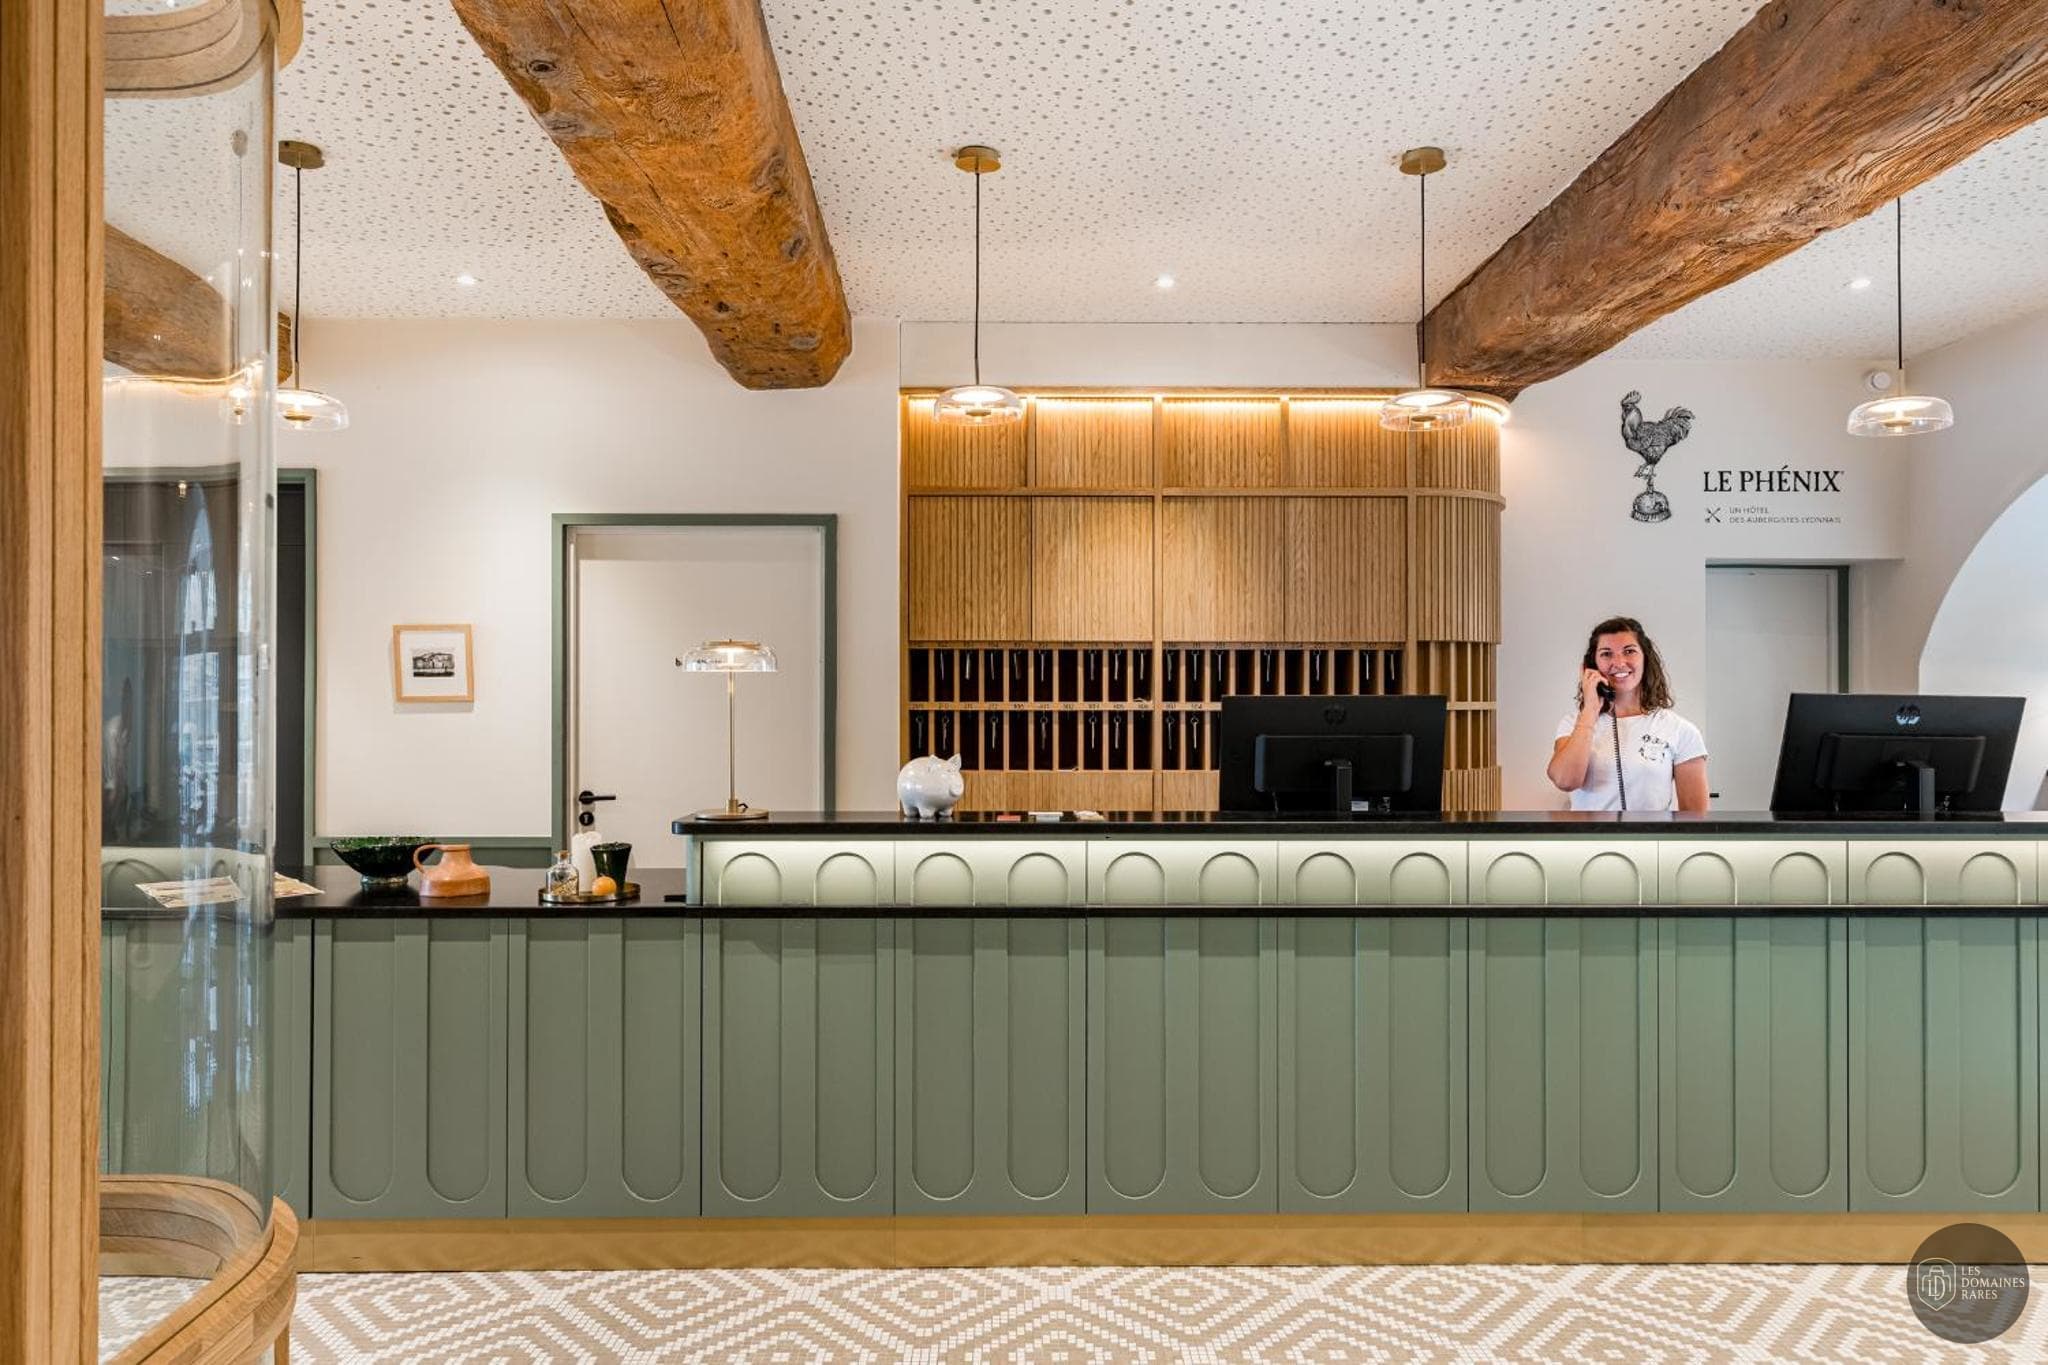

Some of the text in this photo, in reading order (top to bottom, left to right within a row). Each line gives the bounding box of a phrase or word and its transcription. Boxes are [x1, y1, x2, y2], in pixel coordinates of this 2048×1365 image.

[1703, 465, 1841, 492] LE PHÉNIX
[1743, 506, 1769, 514] HÔTEL
[1729, 516, 1744, 524] DES
[1746, 516, 1800, 524] AUBERGISTES
